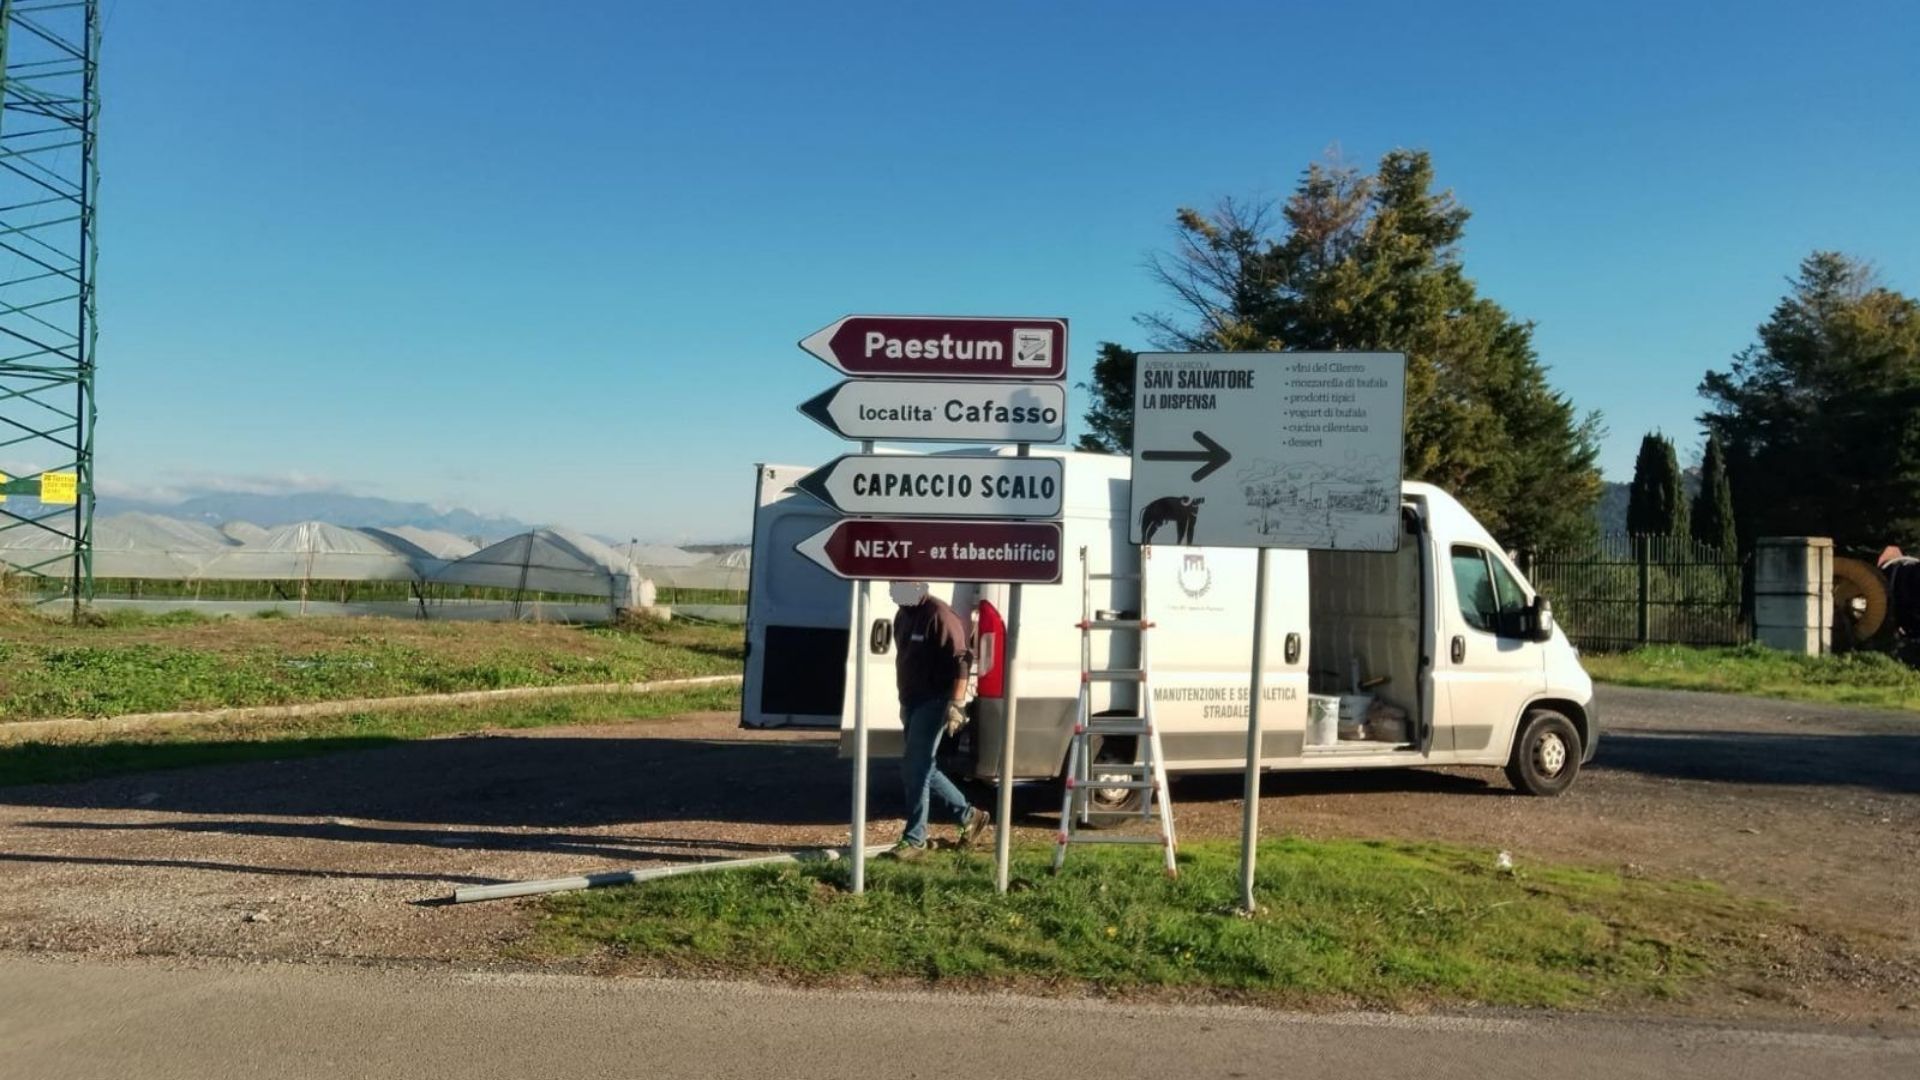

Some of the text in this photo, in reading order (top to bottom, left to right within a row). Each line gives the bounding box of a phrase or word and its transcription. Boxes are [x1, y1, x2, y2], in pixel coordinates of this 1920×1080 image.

[864, 331, 1003, 360] Paestum
[1291, 363, 1366, 373] vini del Cilento
[1143, 370, 1255, 389] SAN SALVATORE
[1291, 377, 1388, 388] mozzarella di bufala
[1142, 394, 1217, 410] LA DISPENSA
[1289, 392, 1356, 405] prodotti tipici
[944, 399, 1057, 424] Cafasso
[1288, 407, 1367, 419] yogurt di bufala
[1287, 421, 1369, 433] cucina cilentana
[1287, 437, 1322, 447] dessert
[853, 473, 1055, 499] CAPACCIO SCALO
[854, 540, 913, 559] NEXT
[930, 546, 947, 560] ex
[952, 542, 1056, 562] tabacchificio
[1154, 687, 1226, 701] MANUTENZIONE
[1229, 687, 1237, 701] E
[1203, 705, 1249, 719] STRADALE
